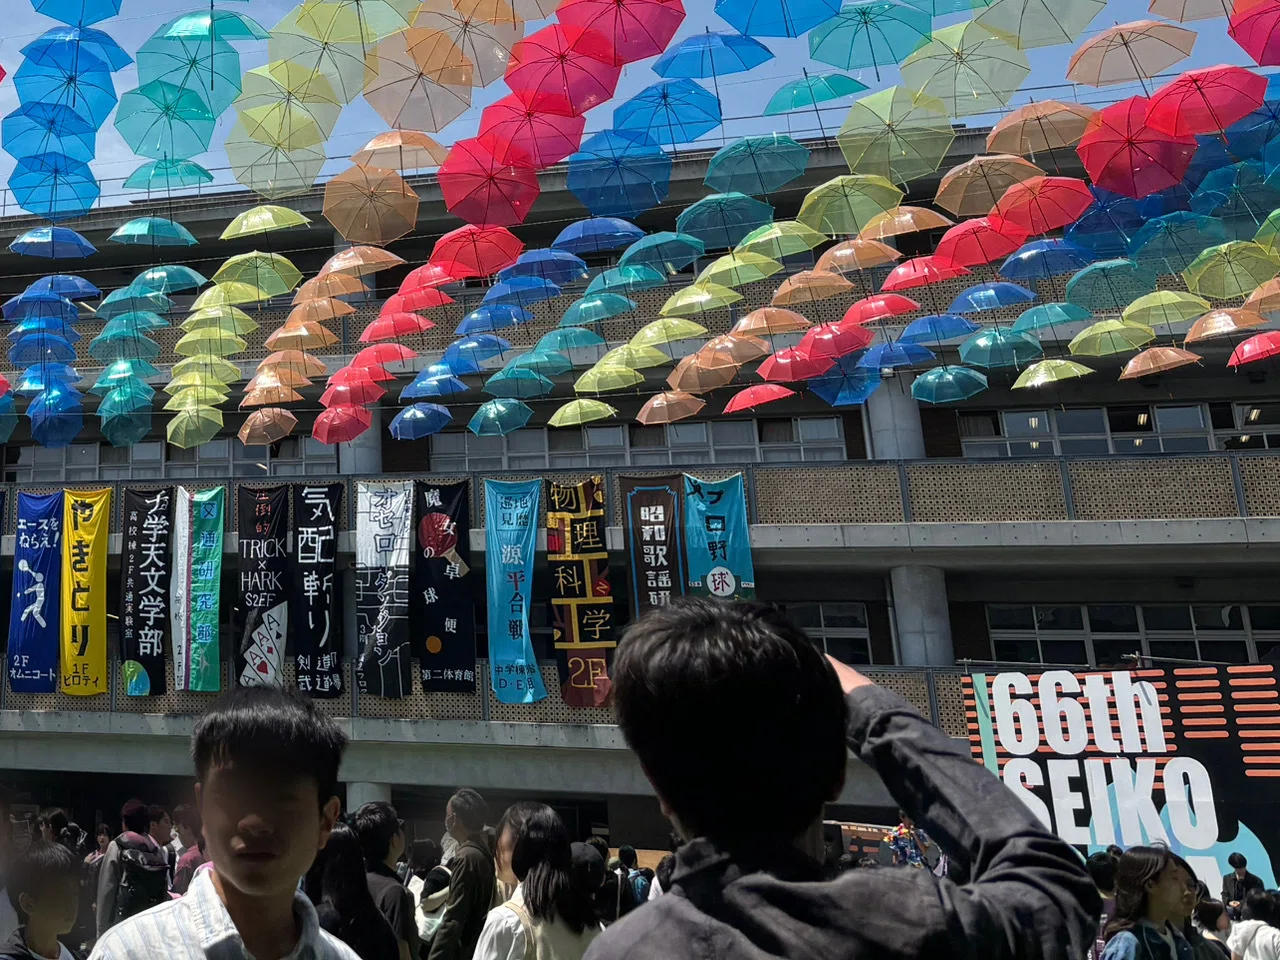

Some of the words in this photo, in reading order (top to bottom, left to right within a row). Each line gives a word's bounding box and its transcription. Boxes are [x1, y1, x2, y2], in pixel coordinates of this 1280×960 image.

[17, 517, 60, 531] エースを
[239, 537, 287, 559] TRICK
[704, 490, 731, 593] プロ野球
[71, 499, 95, 657] やきとり
[196, 501, 217, 643] 交通研究部
[241, 571, 283, 592] HARK
[298, 486, 335, 648] 気配斬り
[500, 544, 525, 641] 源平合戦
[9, 667, 57, 682] オムニコート
[13, 655, 30, 667] 2F
[73, 663, 89, 675] 1F
[421, 669, 475, 683] 第二体育館
[568, 656, 607, 689] 2F
[992, 670, 1167, 755] 66th
[1003, 757, 1219, 850] SEIKO
